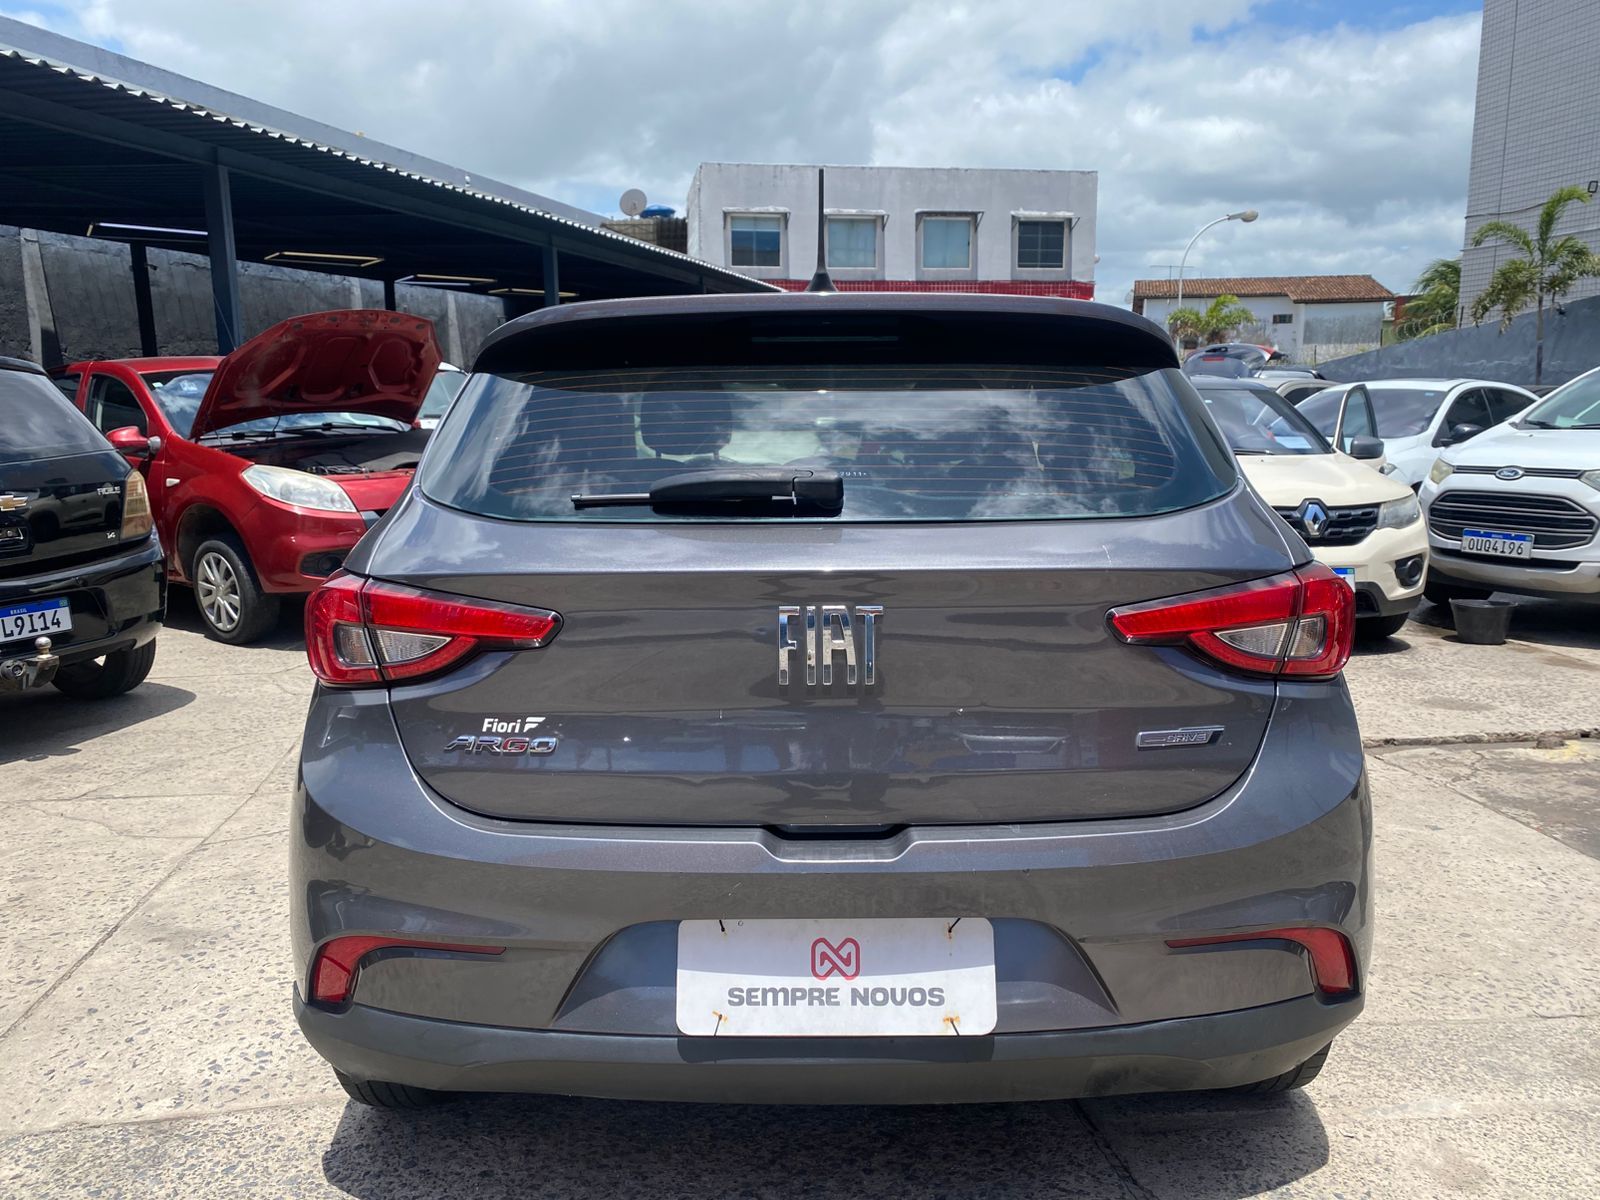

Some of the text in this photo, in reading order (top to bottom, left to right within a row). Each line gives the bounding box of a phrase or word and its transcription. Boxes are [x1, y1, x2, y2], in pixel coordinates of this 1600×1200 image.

[1468, 538, 1524, 555] OUQ4I96
[779, 605, 883, 685] FIAT
[482, 718, 521, 733] Fiori
[444, 736, 557, 753] ARGO
[727, 987, 945, 1007] SEMPRE NOVOS
